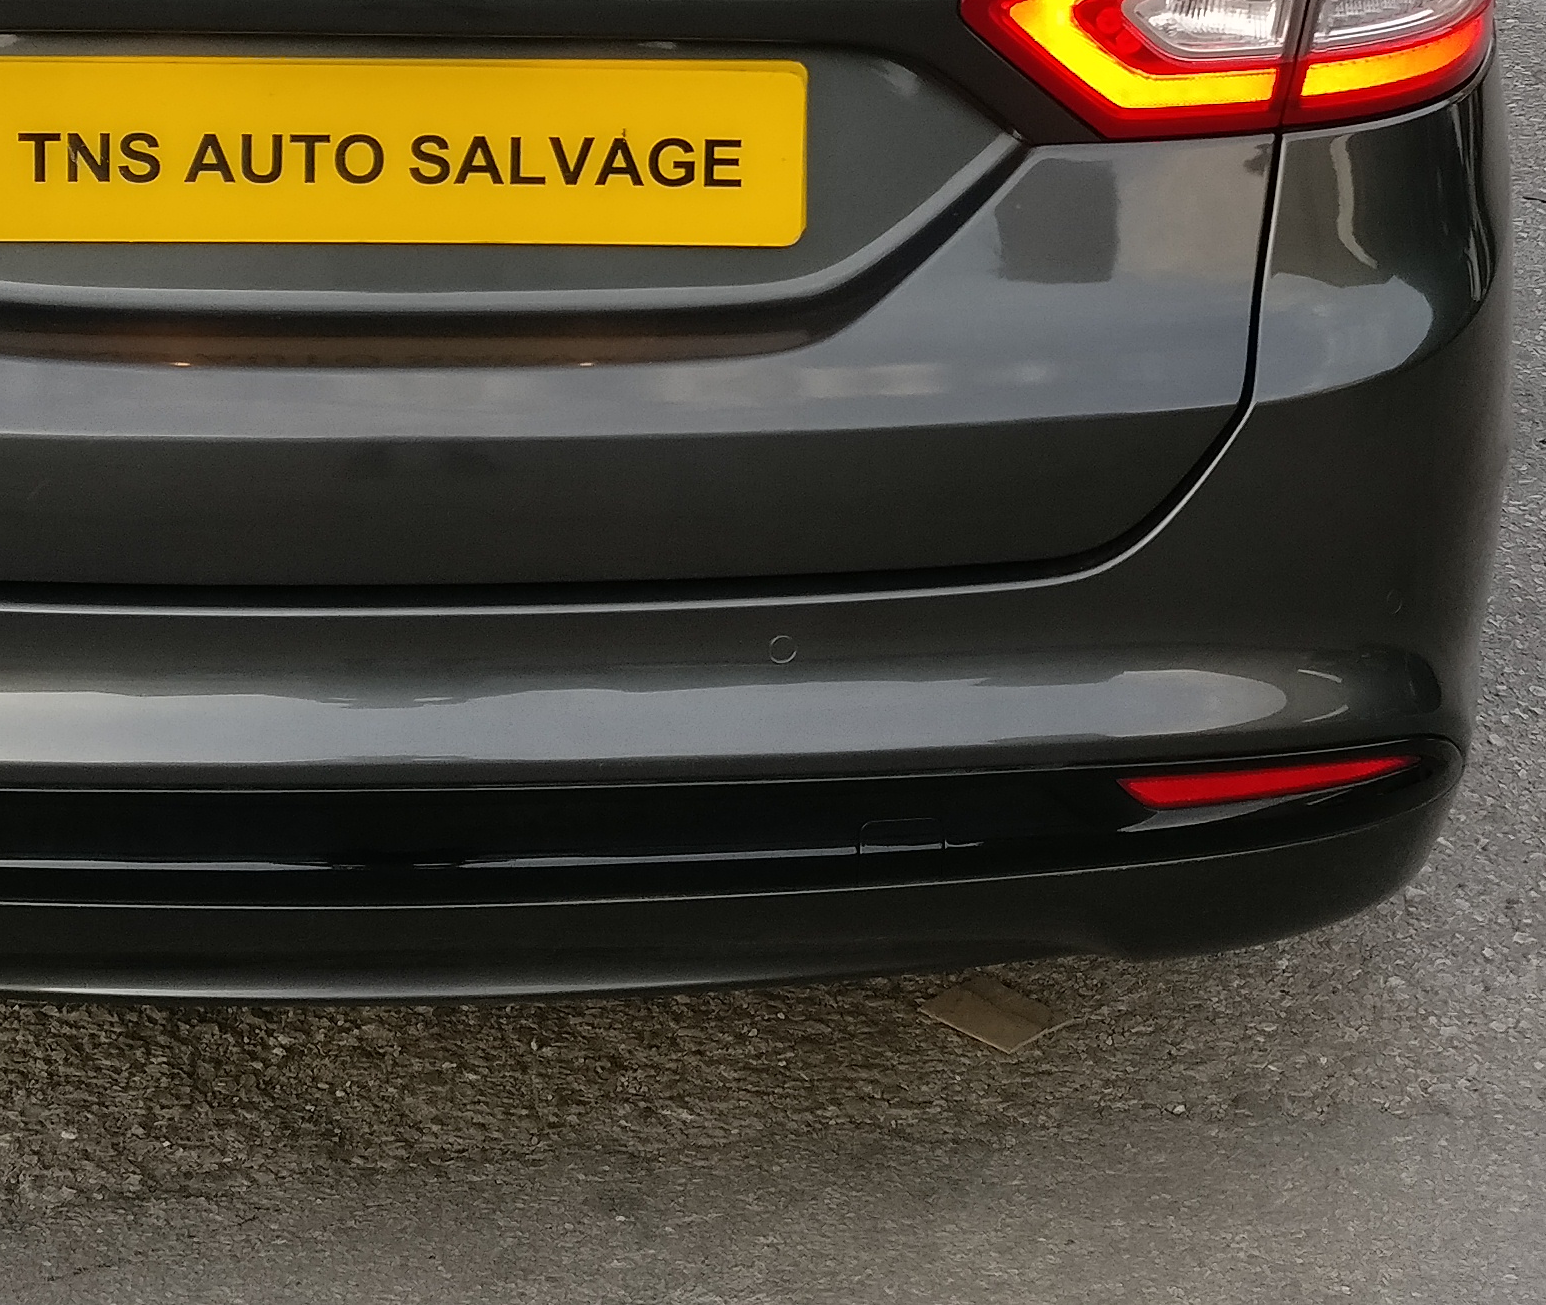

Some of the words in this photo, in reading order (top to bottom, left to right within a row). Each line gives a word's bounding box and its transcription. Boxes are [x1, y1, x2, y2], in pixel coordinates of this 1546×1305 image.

[18, 132, 161, 183] TNS
[184, 133, 384, 185] AUTO
[409, 135, 742, 188] SALVAGE
